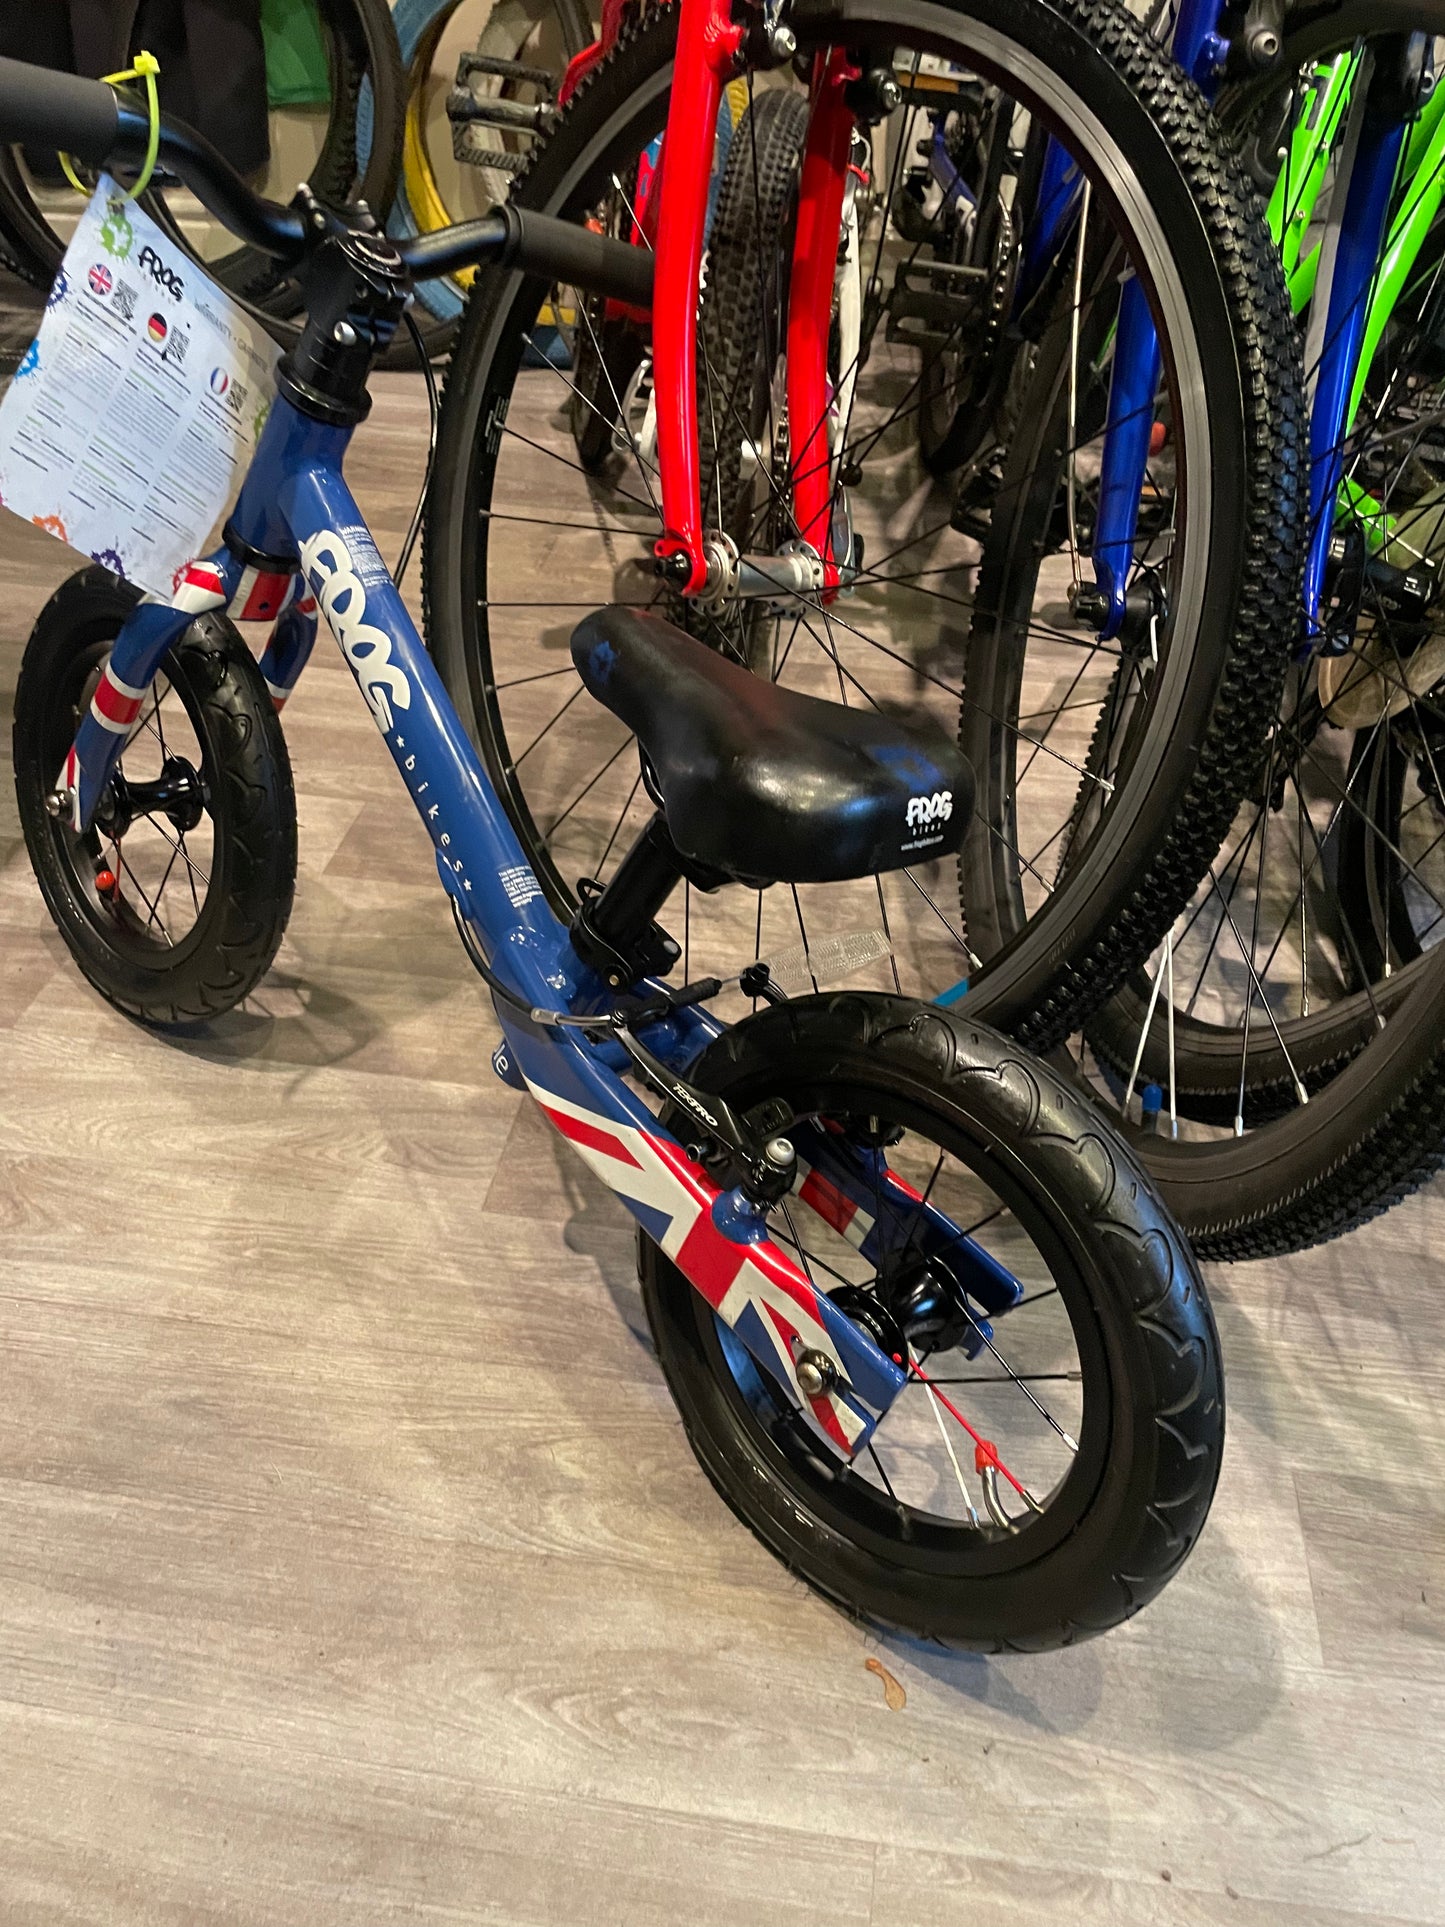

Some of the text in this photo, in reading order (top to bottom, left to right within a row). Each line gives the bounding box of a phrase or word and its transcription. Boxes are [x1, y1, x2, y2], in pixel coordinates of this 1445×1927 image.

[138, 245, 184, 302] FROG
[405, 755, 463, 872] bikes
[905, 790, 953, 827] FROG
[493, 1043, 508, 1076] le
[672, 1082, 718, 1127] TEKTRO
